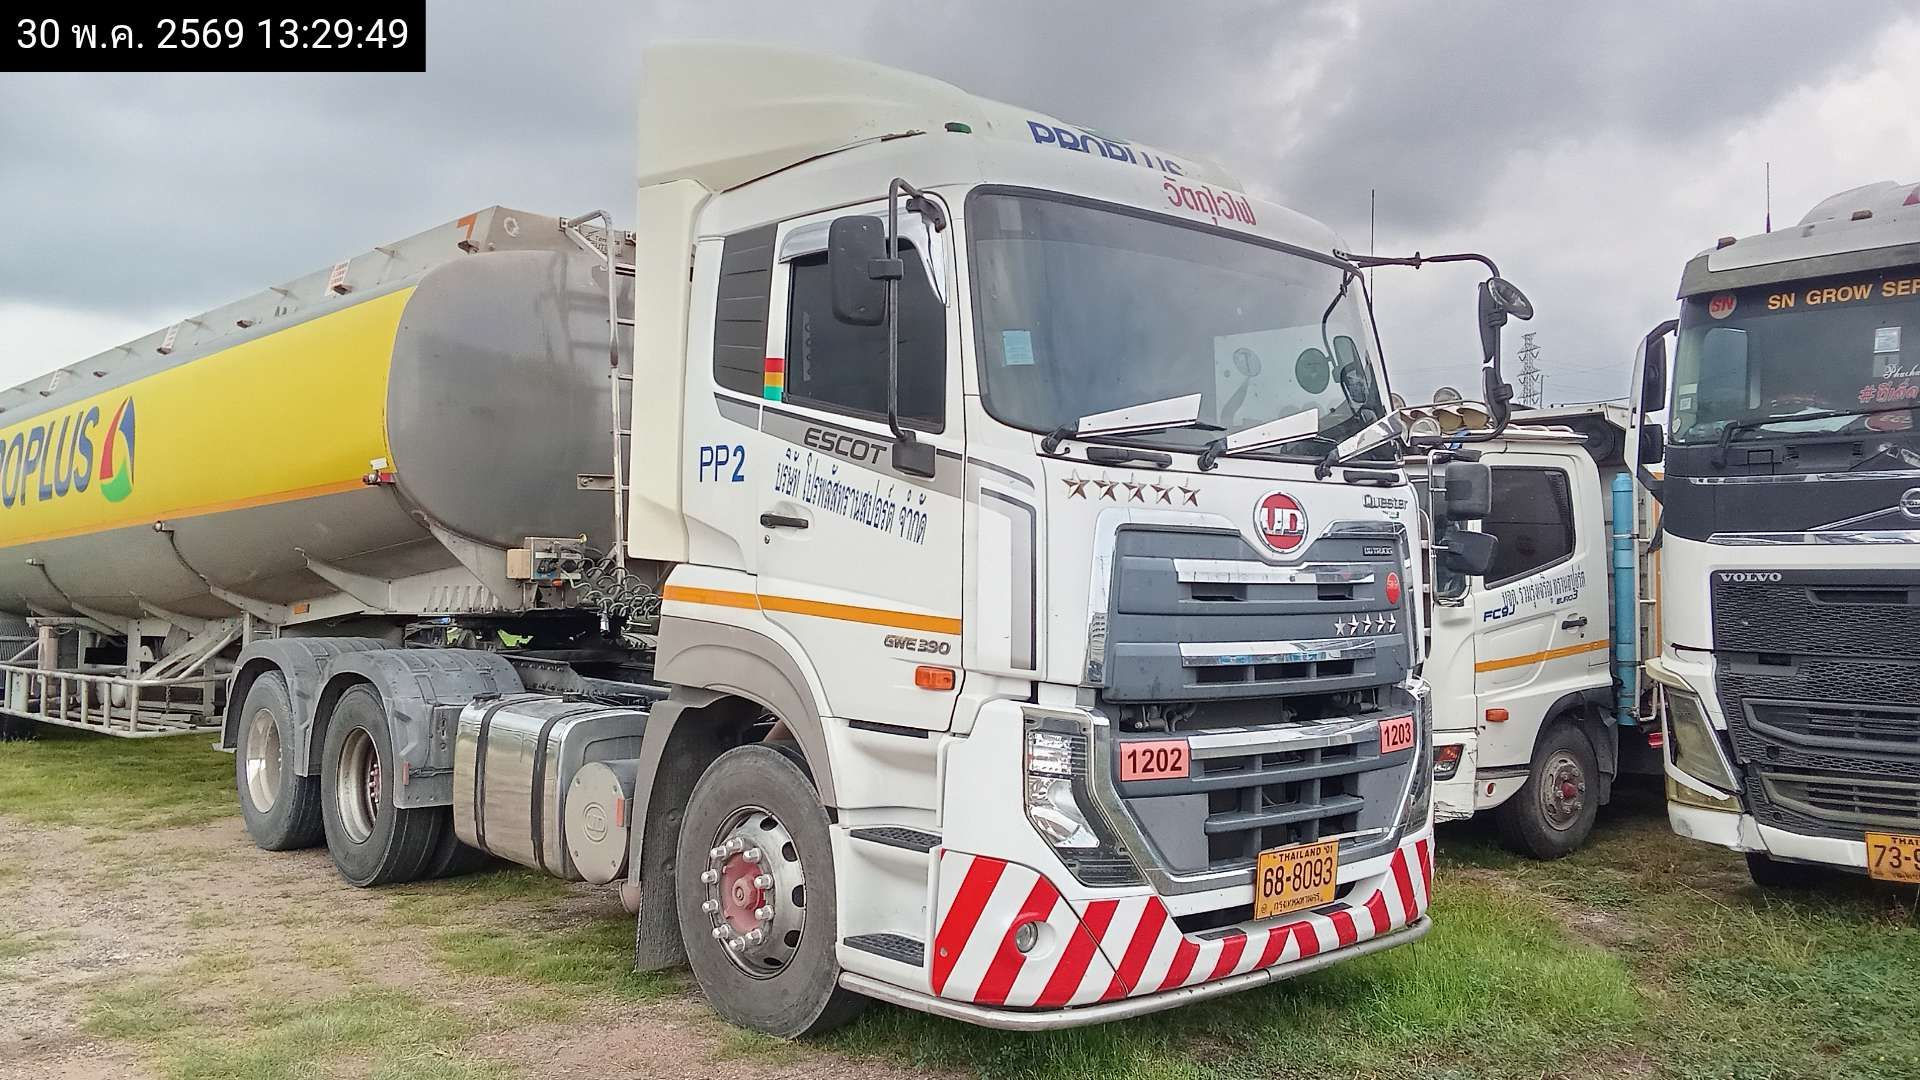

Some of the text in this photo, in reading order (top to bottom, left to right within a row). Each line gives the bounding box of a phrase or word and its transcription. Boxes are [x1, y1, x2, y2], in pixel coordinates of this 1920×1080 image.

[1767, 292, 1796, 310] SN
[1806, 284, 1873, 306] GROW
[803, 427, 888, 464] ESCOT
[699, 444, 746, 483] PP2
[775, 447, 801, 498] บริษัท
[899, 489, 928, 545] จำกัด
[1363, 493, 1409, 511] Quester
[1259, 507, 1306, 535] UD
[1718, 572, 1782, 582] VOLVO
[884, 634, 951, 655] GWE 390
[1384, 722, 1412, 747] 1203
[1127, 747, 1182, 774] 1202
[1279, 847, 1321, 862] THAILAND
[1263, 857, 1333, 898] 68-8093
